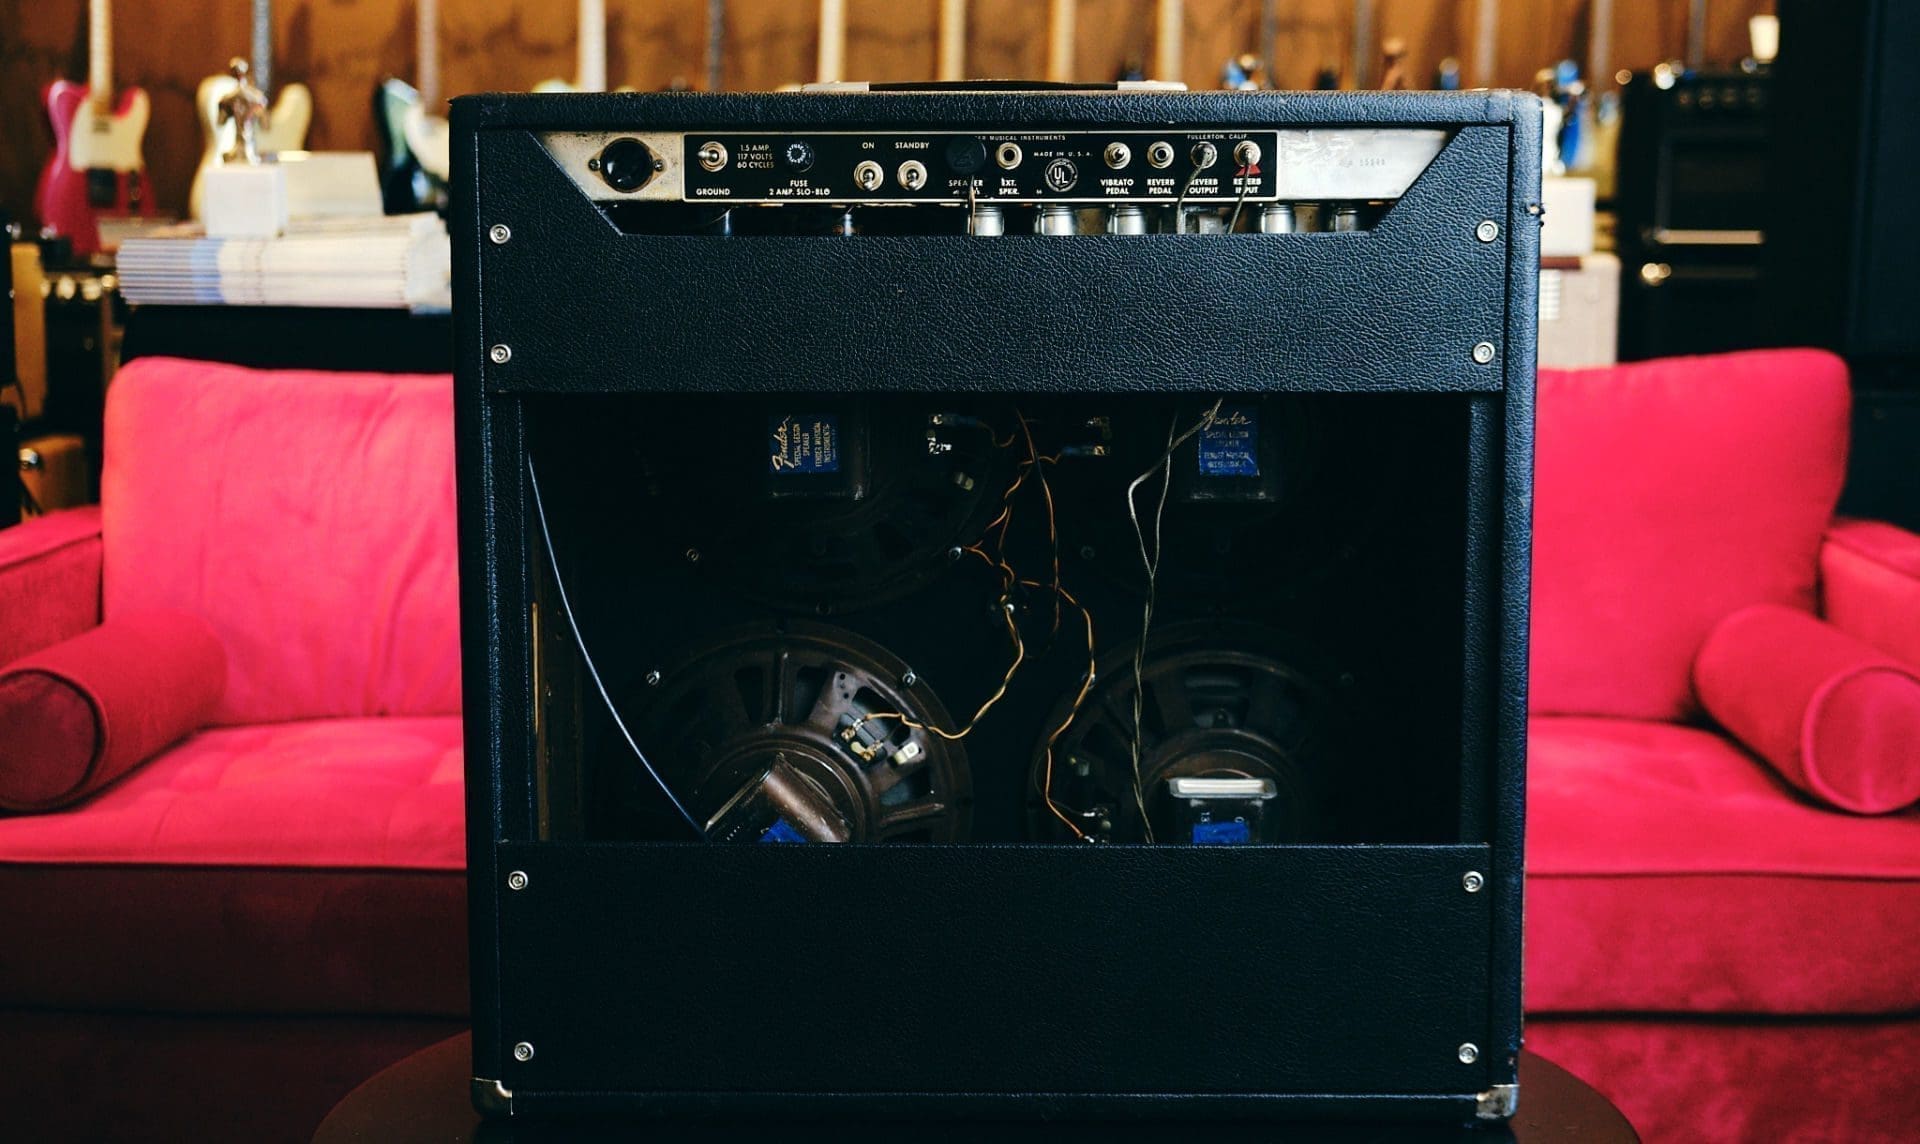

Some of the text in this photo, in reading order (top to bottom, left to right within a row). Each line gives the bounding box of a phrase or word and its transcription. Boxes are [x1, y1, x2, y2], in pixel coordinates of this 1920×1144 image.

[737, 161, 775, 169] 60 CYCLES
[948, 179, 984, 187] SPEAER
[1100, 178, 1134, 186] VIBRATO
[1146, 178, 1175, 186] REVERB
[695, 188, 731, 196] GROUND
[768, 188, 774, 196] 2
[775, 188, 794, 196] AMP.
[1105, 187, 1130, 195] PEDAL
[1148, 187, 1173, 195] PEDAL
[1188, 187, 1219, 195] OUTPUT
[772, 415, 795, 470] Fender
[802, 432, 810, 456] SPEAKER
